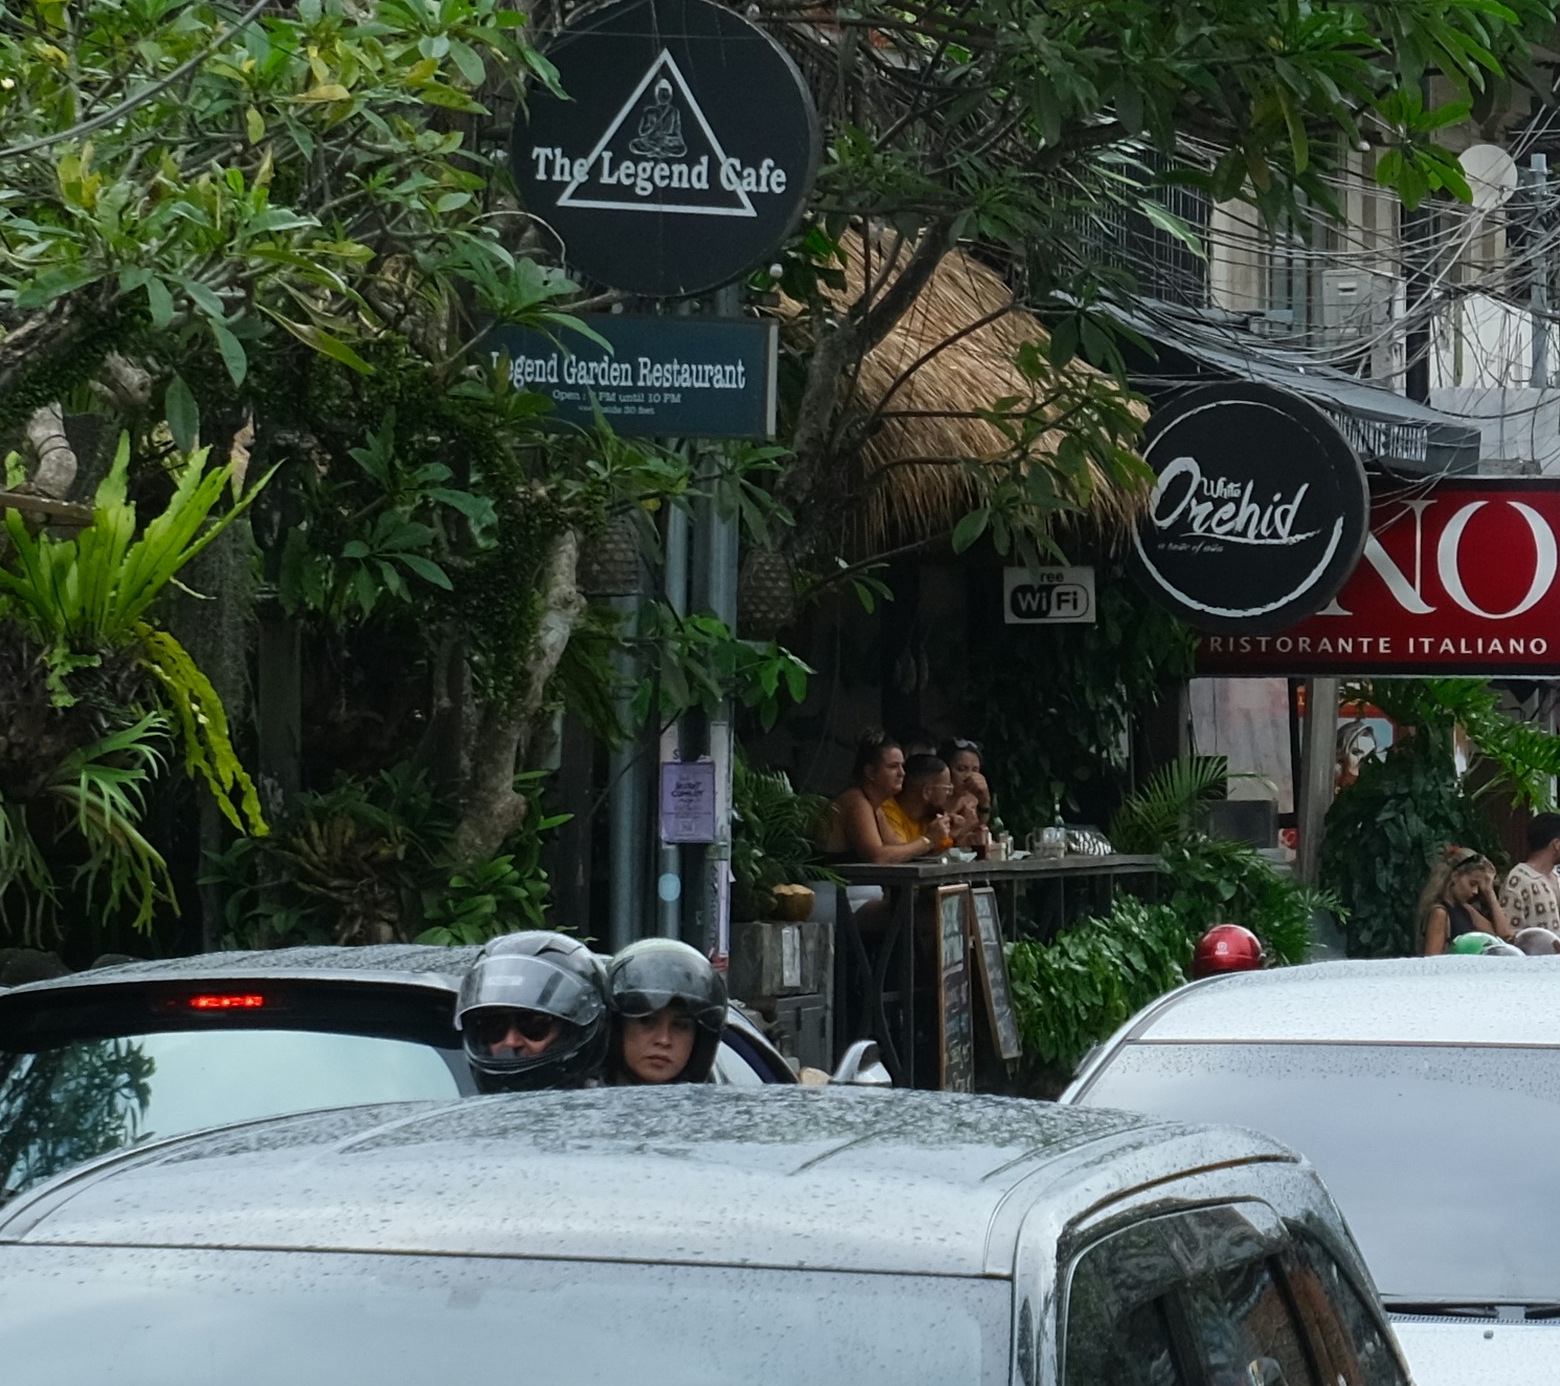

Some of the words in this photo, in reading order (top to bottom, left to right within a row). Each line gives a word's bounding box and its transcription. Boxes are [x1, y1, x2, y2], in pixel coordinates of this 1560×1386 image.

[532, 146, 589, 183] The
[600, 151, 710, 197] Legend
[720, 156, 787, 195] Cafe
[563, 353, 633, 387] Garden
[637, 356, 746, 389] Restaurant
[552, 389, 581, 402] Open
[619, 392, 645, 403] until
[663, 393, 681, 403] PM
[1149, 456, 1310, 540] Orchid
[1201, 476, 1242, 499] White
[1040, 572, 1065, 583] ree
[1016, 591, 1079, 611] WiFi
[1209, 635, 1392, 655] RISTORANTE
[1408, 636, 1548, 656] ITALIANO
